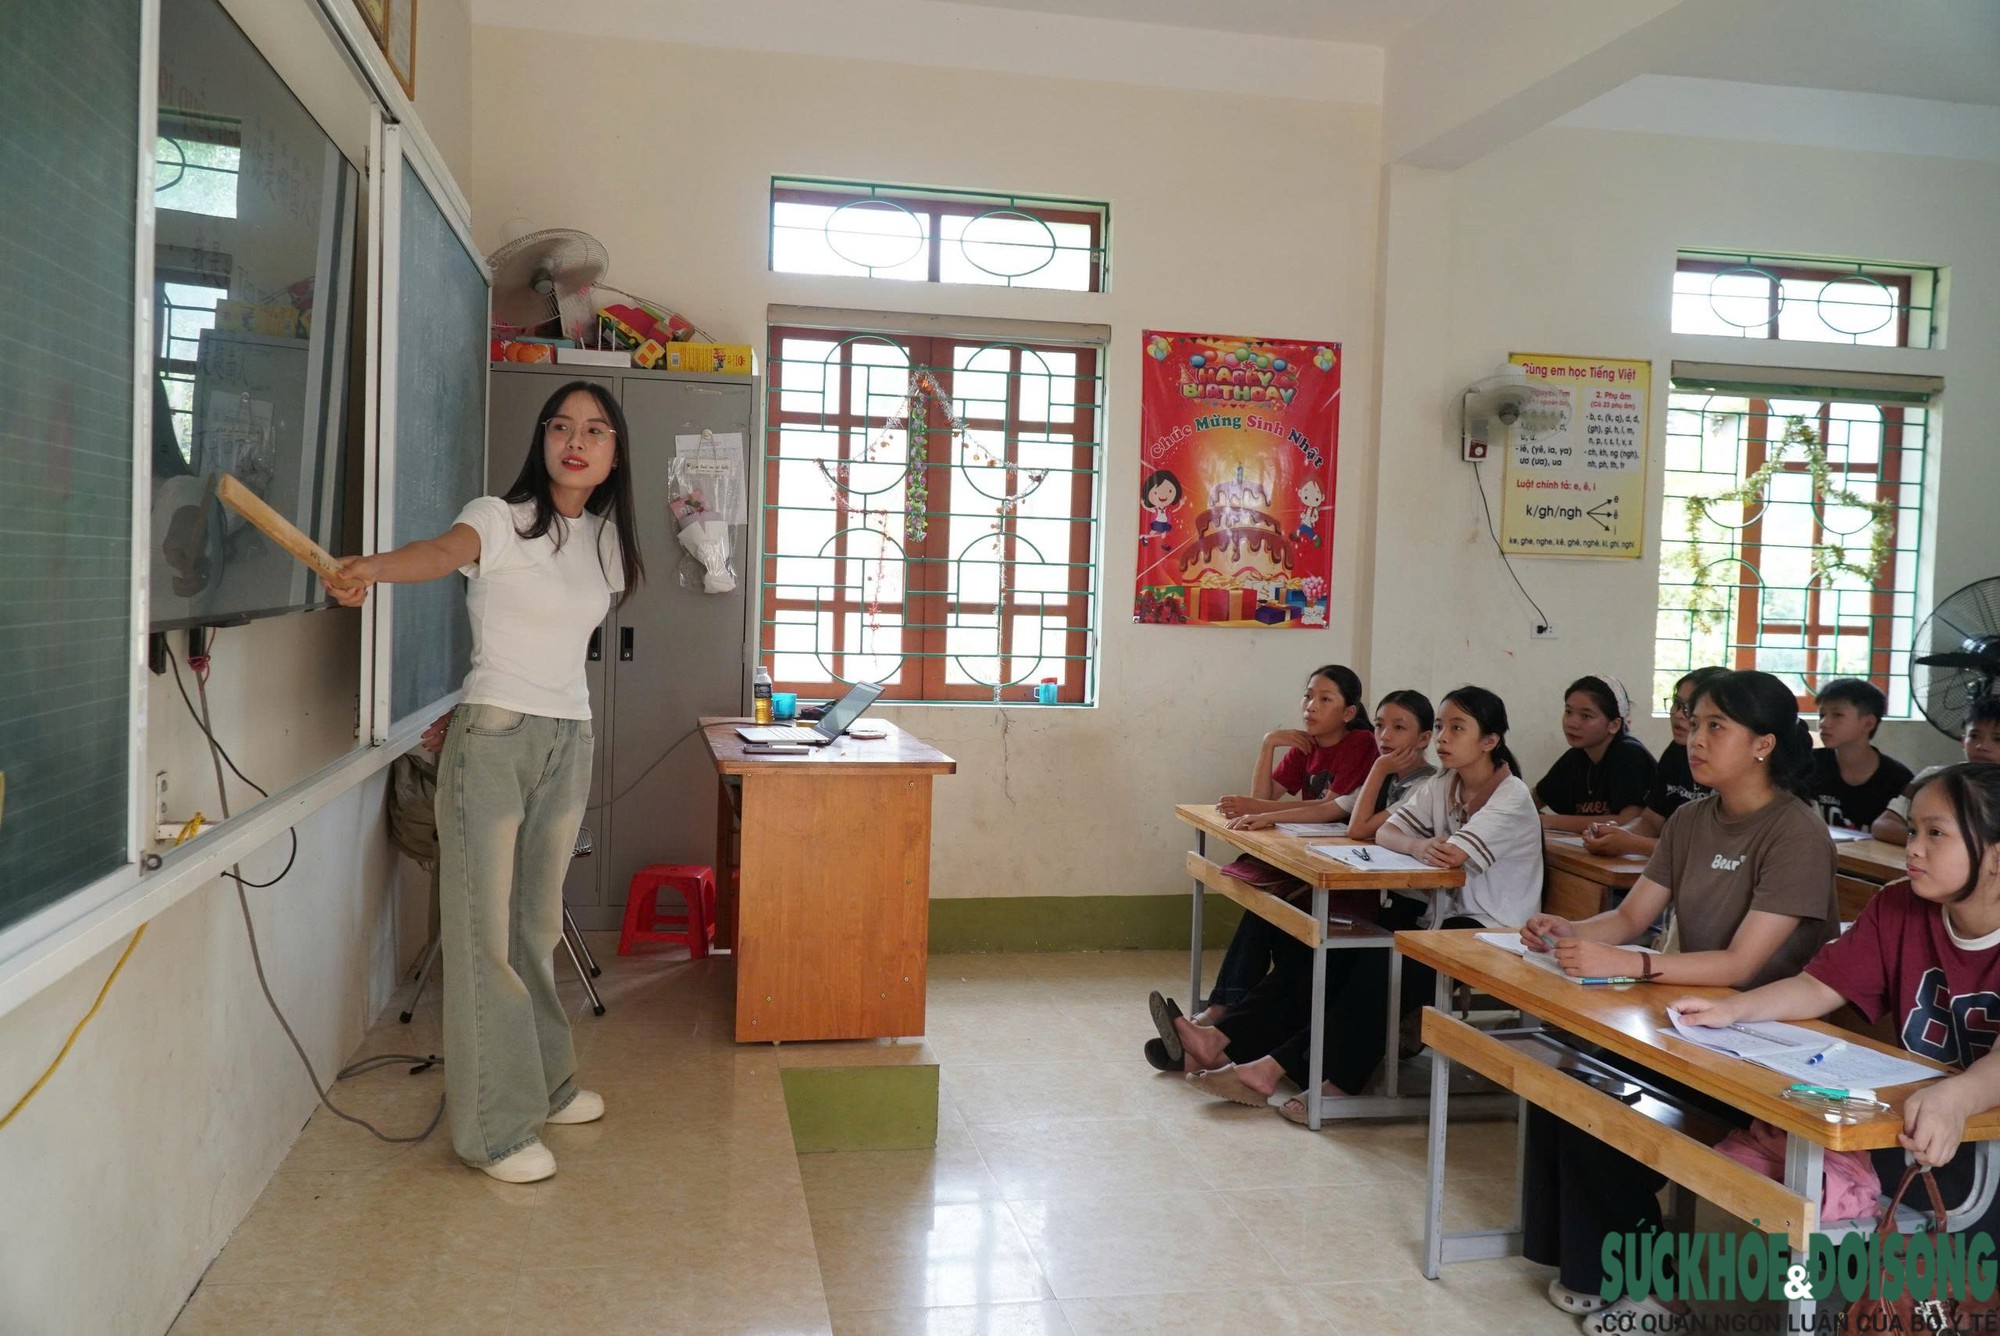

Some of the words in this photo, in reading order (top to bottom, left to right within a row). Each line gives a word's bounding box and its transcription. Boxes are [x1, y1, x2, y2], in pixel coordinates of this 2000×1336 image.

[1197, 366, 1274, 388] HAPPY
[1551, 366, 1566, 377] em
[1568, 365, 1587, 381] học
[1589, 365, 1615, 383] Tiếng
[1618, 368, 1636, 384] Việt
[1180, 382, 1297, 406] BIRTHDAY
[1150, 424, 1193, 459] Chúc
[1194, 413, 1242, 432] Mừng
[1246, 414, 1286, 438] Sinh
[1287, 428, 1324, 468] Nhật
[1516, 479, 1534, 491] Luật
[1536, 479, 1559, 489] chính
[1560, 480, 1572, 490] tả:
[1525, 504, 1583, 521] k/gh/ngh
